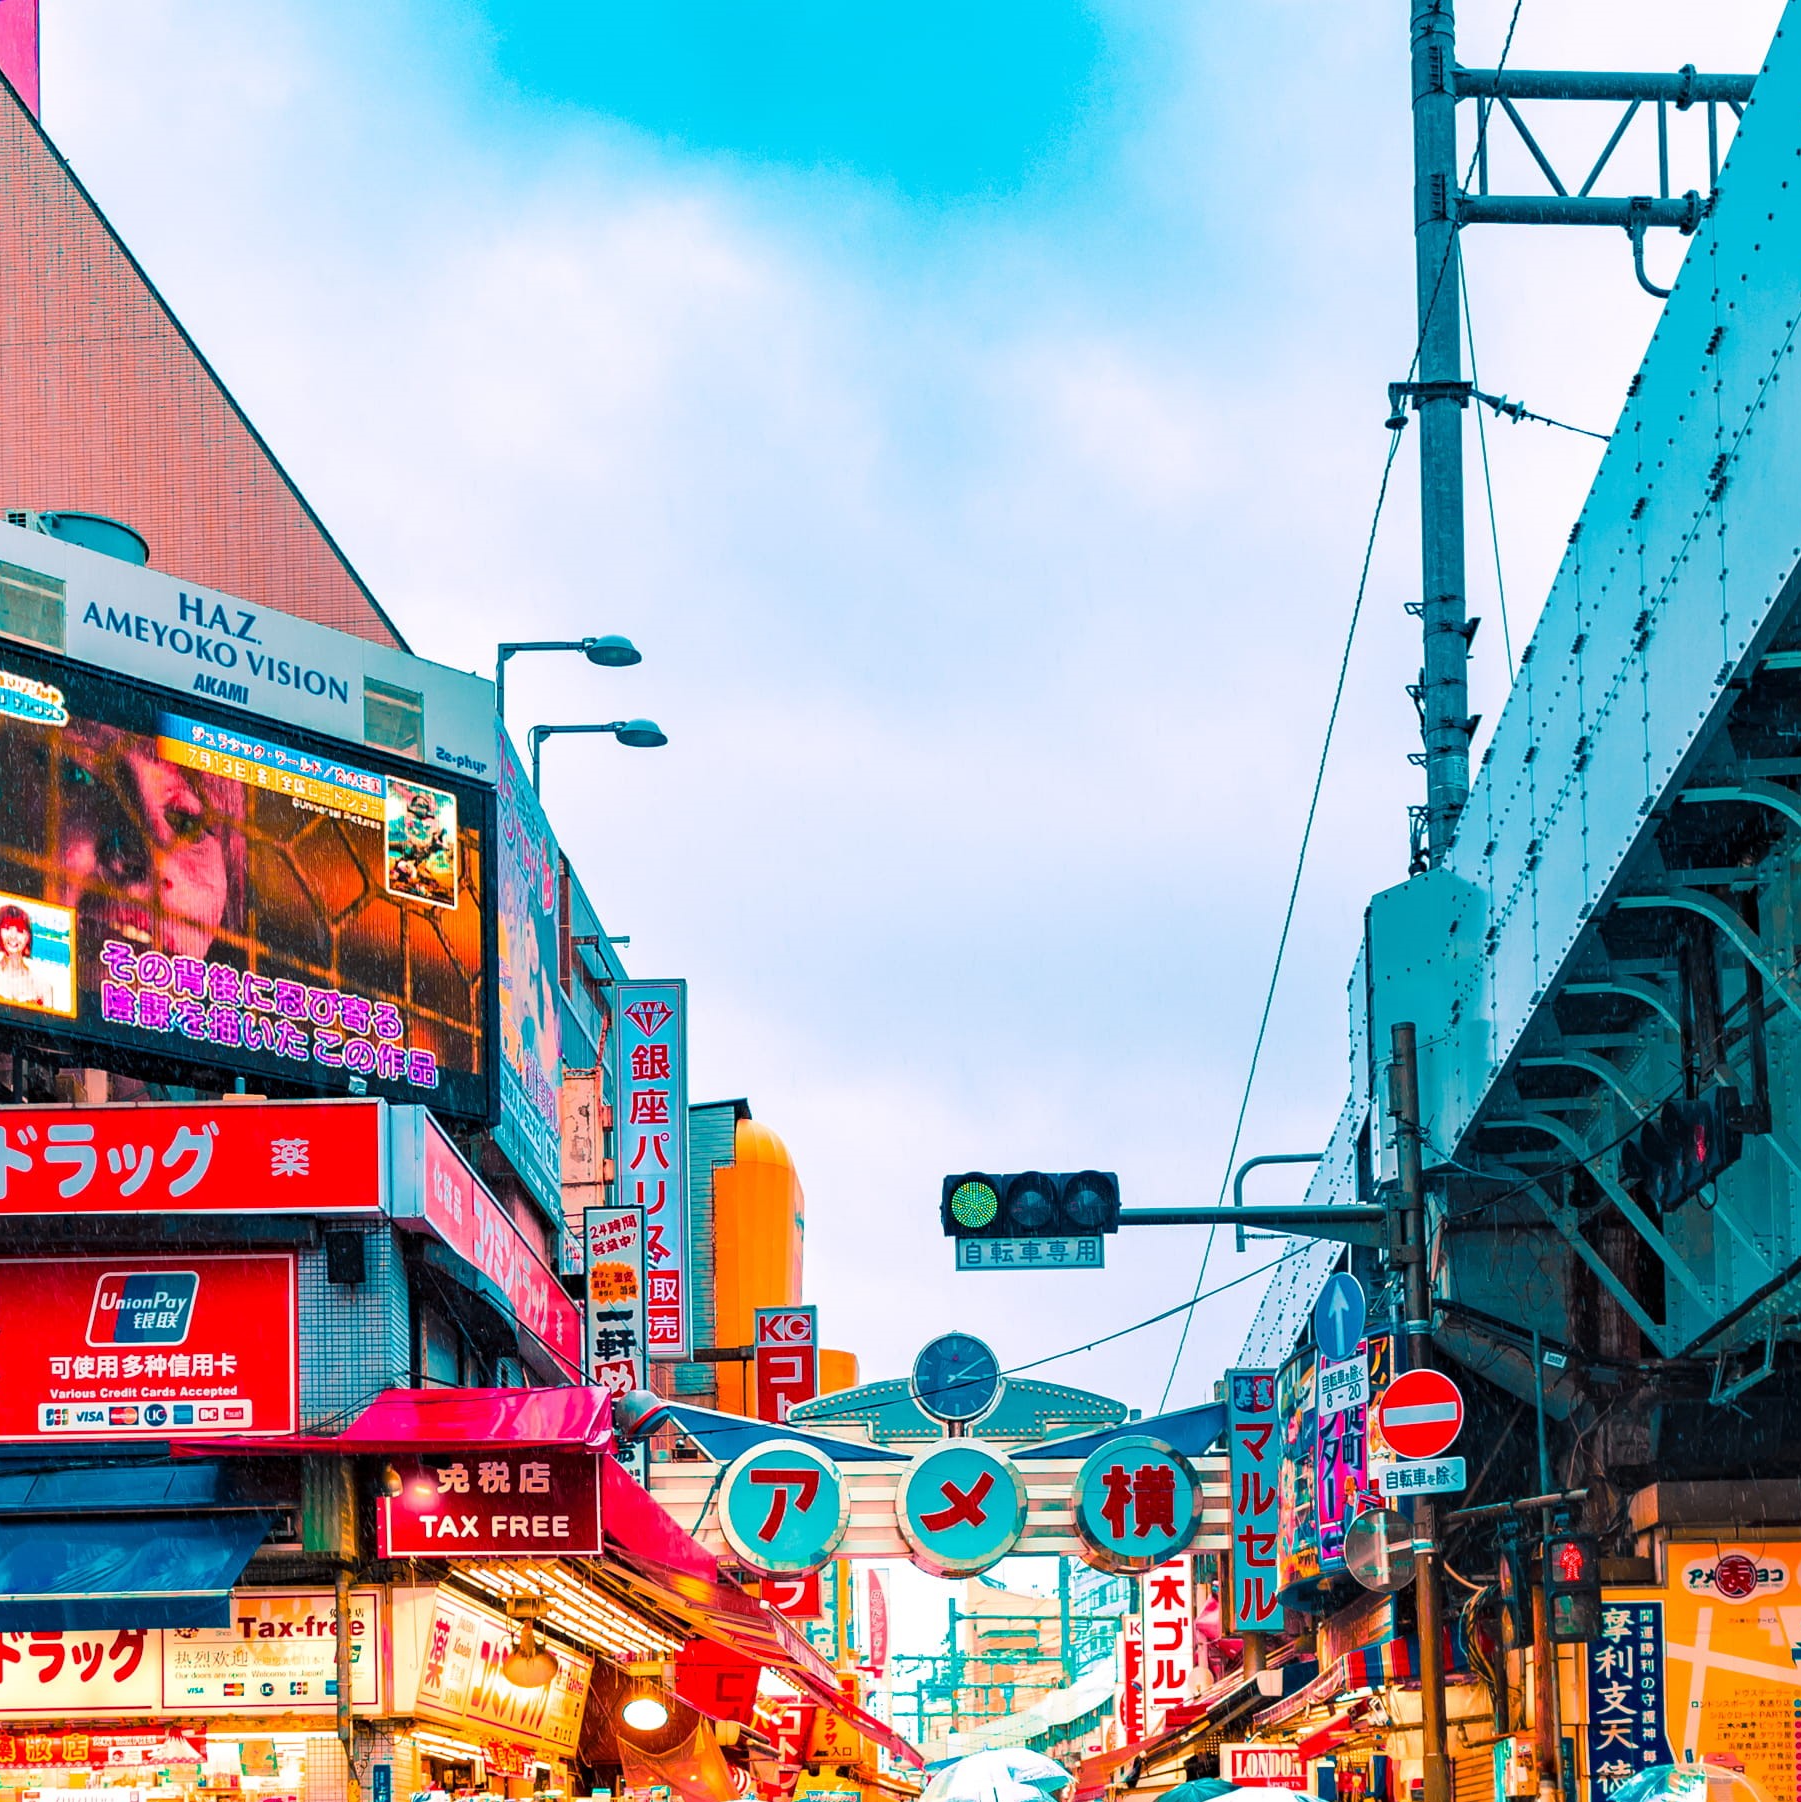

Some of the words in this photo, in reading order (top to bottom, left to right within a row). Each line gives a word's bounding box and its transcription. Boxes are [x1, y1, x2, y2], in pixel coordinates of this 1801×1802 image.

[83, 601, 240, 669] AMEYOKO
[246, 652, 348, 704] VISION
[194, 673, 249, 705] AKAMI
[102, 940, 404, 1040] その背後に忍び寄る
[101, 981, 438, 1088] 陰謀を描いたこの作品
[271, 1137, 310, 1177] 薬
[629, 1043, 673, 1263] 銀座パリス
[433, 1161, 463, 1226] 化粧品
[589, 1214, 638, 1239] 24時間
[965, 1240, 1096, 1265] 自転車専用
[473, 1198, 548, 1337] コクミンドラッグ
[100, 1292, 187, 1316] UnionPay
[134, 1312, 179, 1329] 银联
[758, 1315, 811, 1342] KG
[49, 1353, 237, 1379] 可使用多种信用卡
[1321, 1367, 1363, 1392] 自転車を除く
[50, 1388, 96, 1399] Various
[100, 1387, 137, 1398] Credit
[141, 1387, 176, 1397] Cards
[180, 1386, 238, 1397] Accepted
[437, 1461, 551, 1495] 免税店
[1385, 1466, 1459, 1489] 自転車を除く
[419, 1515, 481, 1539] TAX
[490, 1514, 570, 1539] FREE
[1234, 1420, 1278, 1623] マルセル
